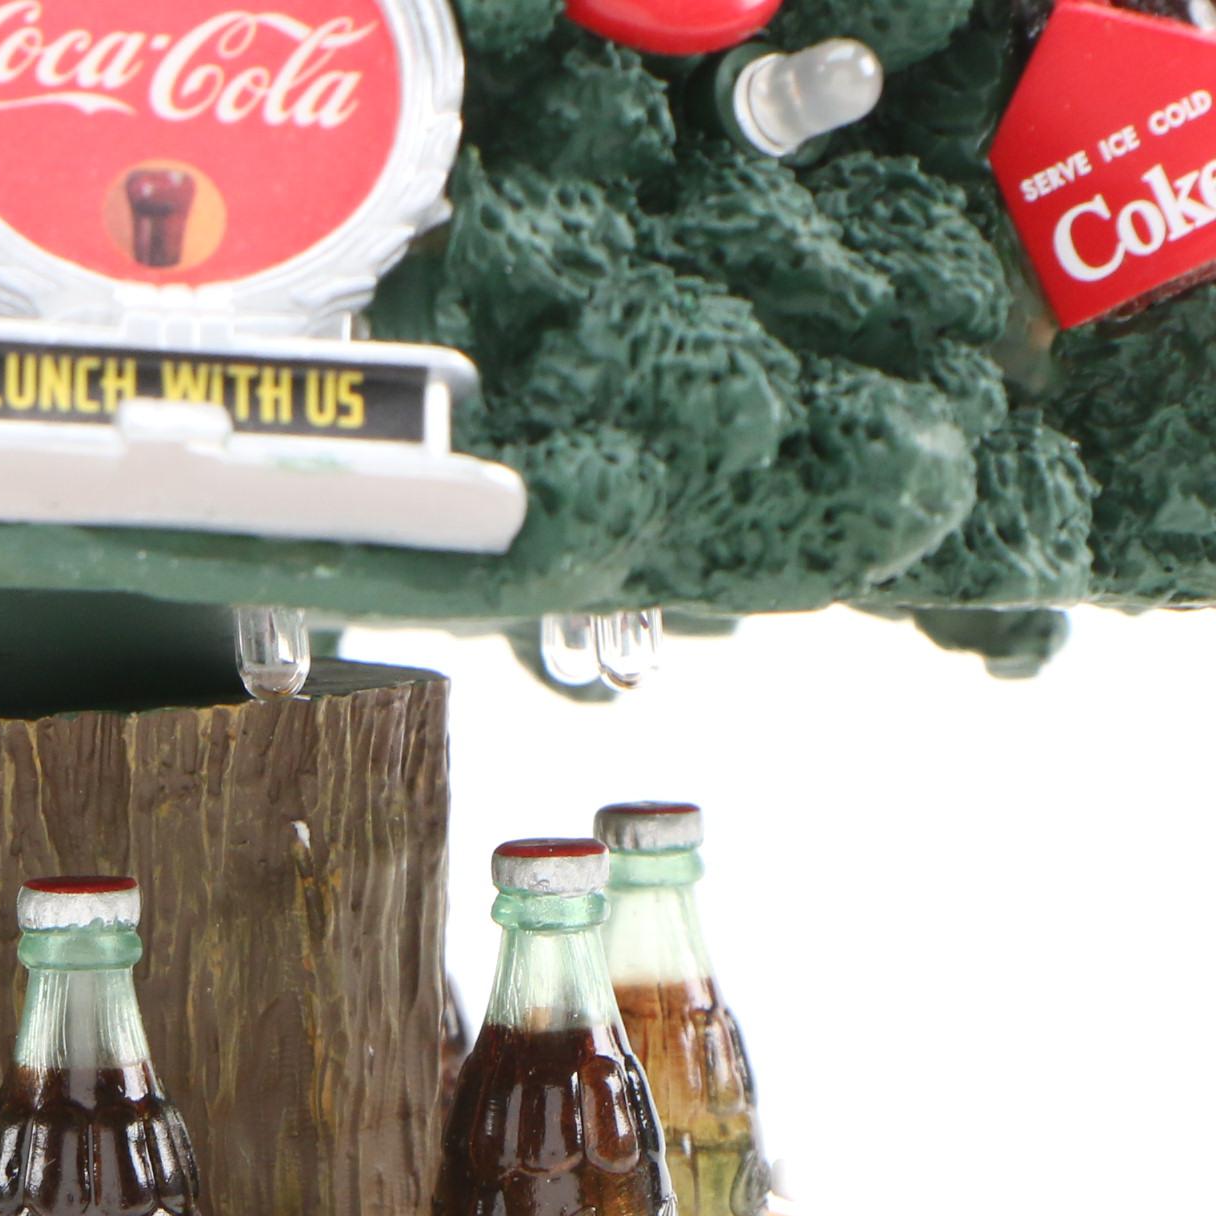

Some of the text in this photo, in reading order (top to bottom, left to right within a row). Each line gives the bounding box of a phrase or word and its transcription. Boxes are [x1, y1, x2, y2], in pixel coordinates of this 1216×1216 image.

[1019, 89, 1214, 202] SERVE ICE COLD
[160, 358, 293, 425] WITH
[304, 368, 366, 430] US
